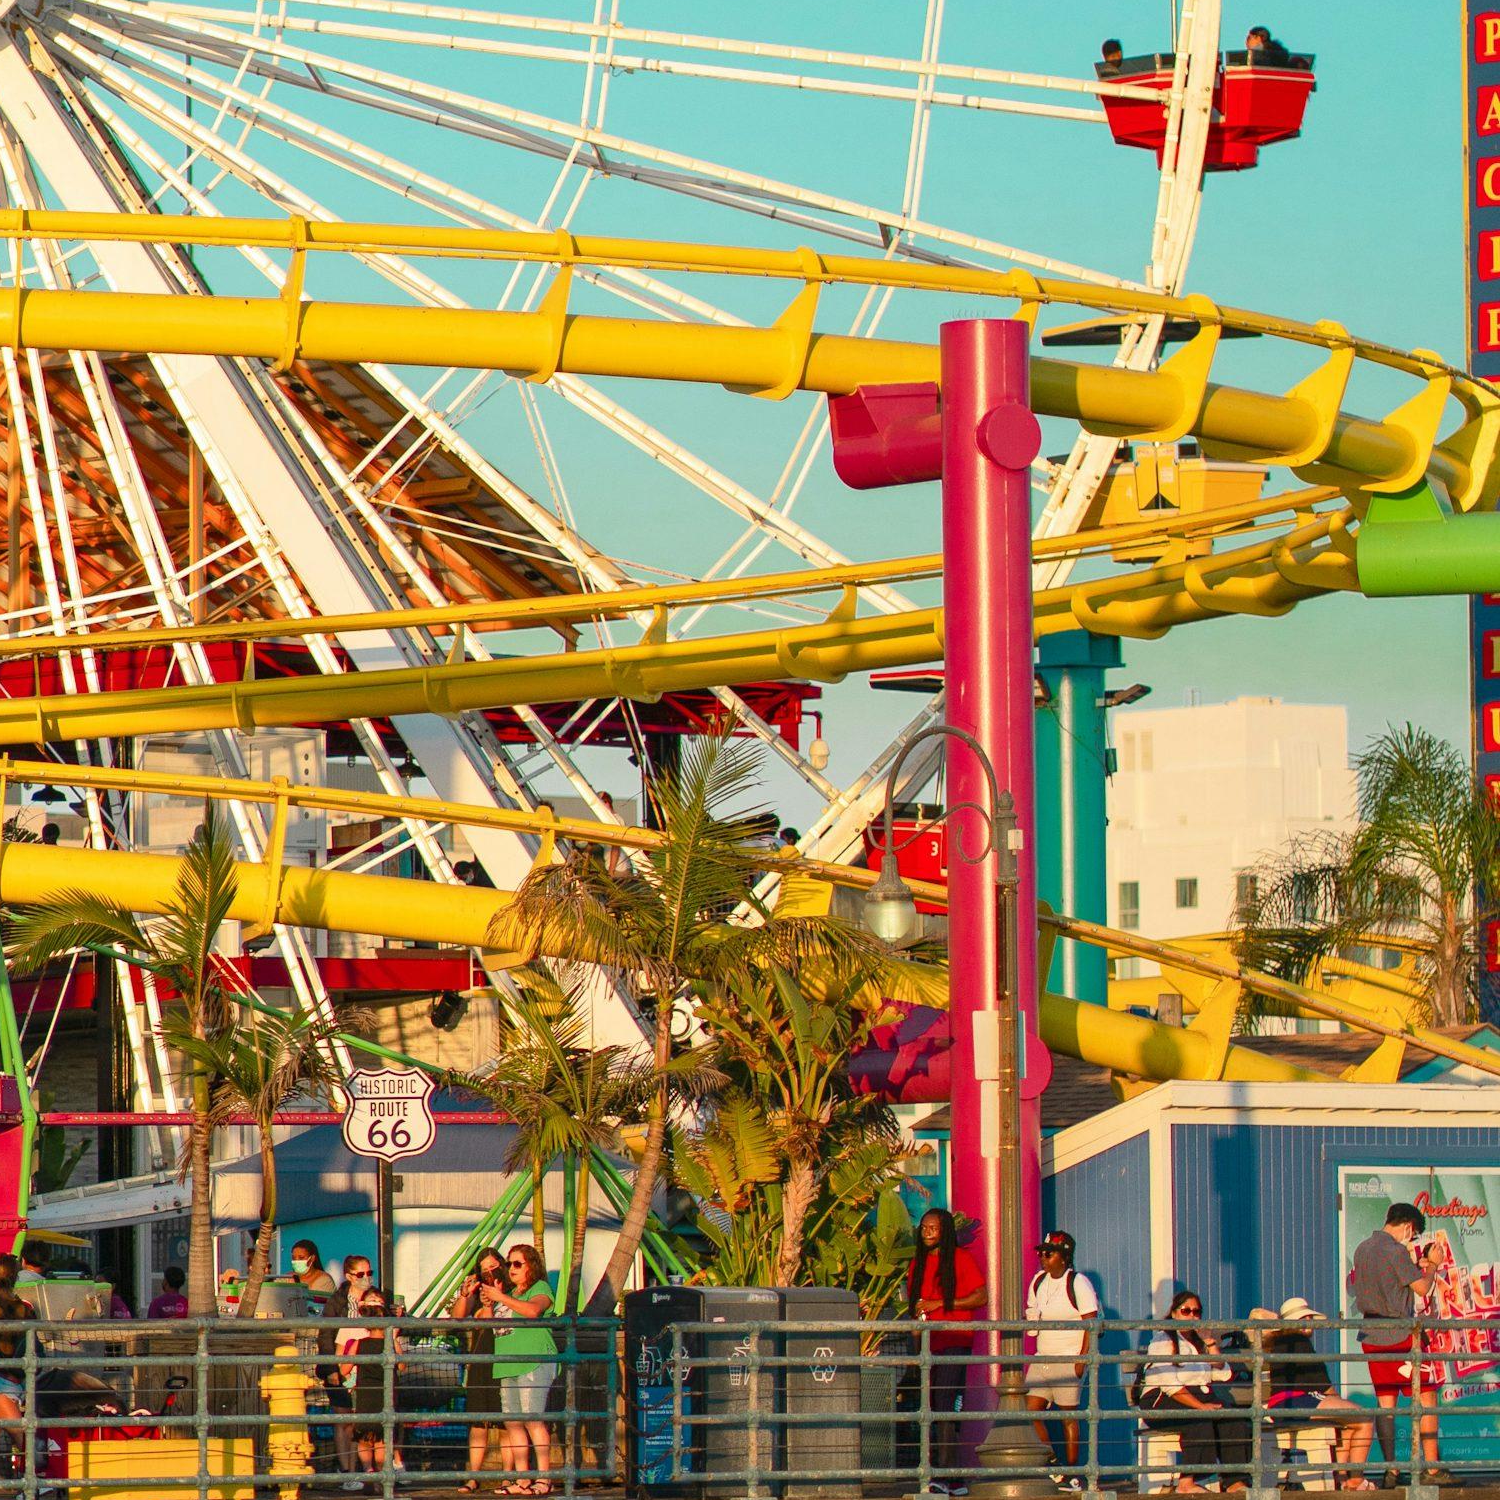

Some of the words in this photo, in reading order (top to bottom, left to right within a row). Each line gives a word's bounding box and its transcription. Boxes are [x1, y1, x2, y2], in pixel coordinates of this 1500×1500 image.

[930, 841, 939, 857] 3
[360, 1079, 417, 1094] HISTORIC
[370, 1101, 408, 1117] ROUTE
[367, 1118, 411, 1149] 66
[1413, 1190, 1488, 1226] Greetings
[1459, 1220, 1485, 1245] from
